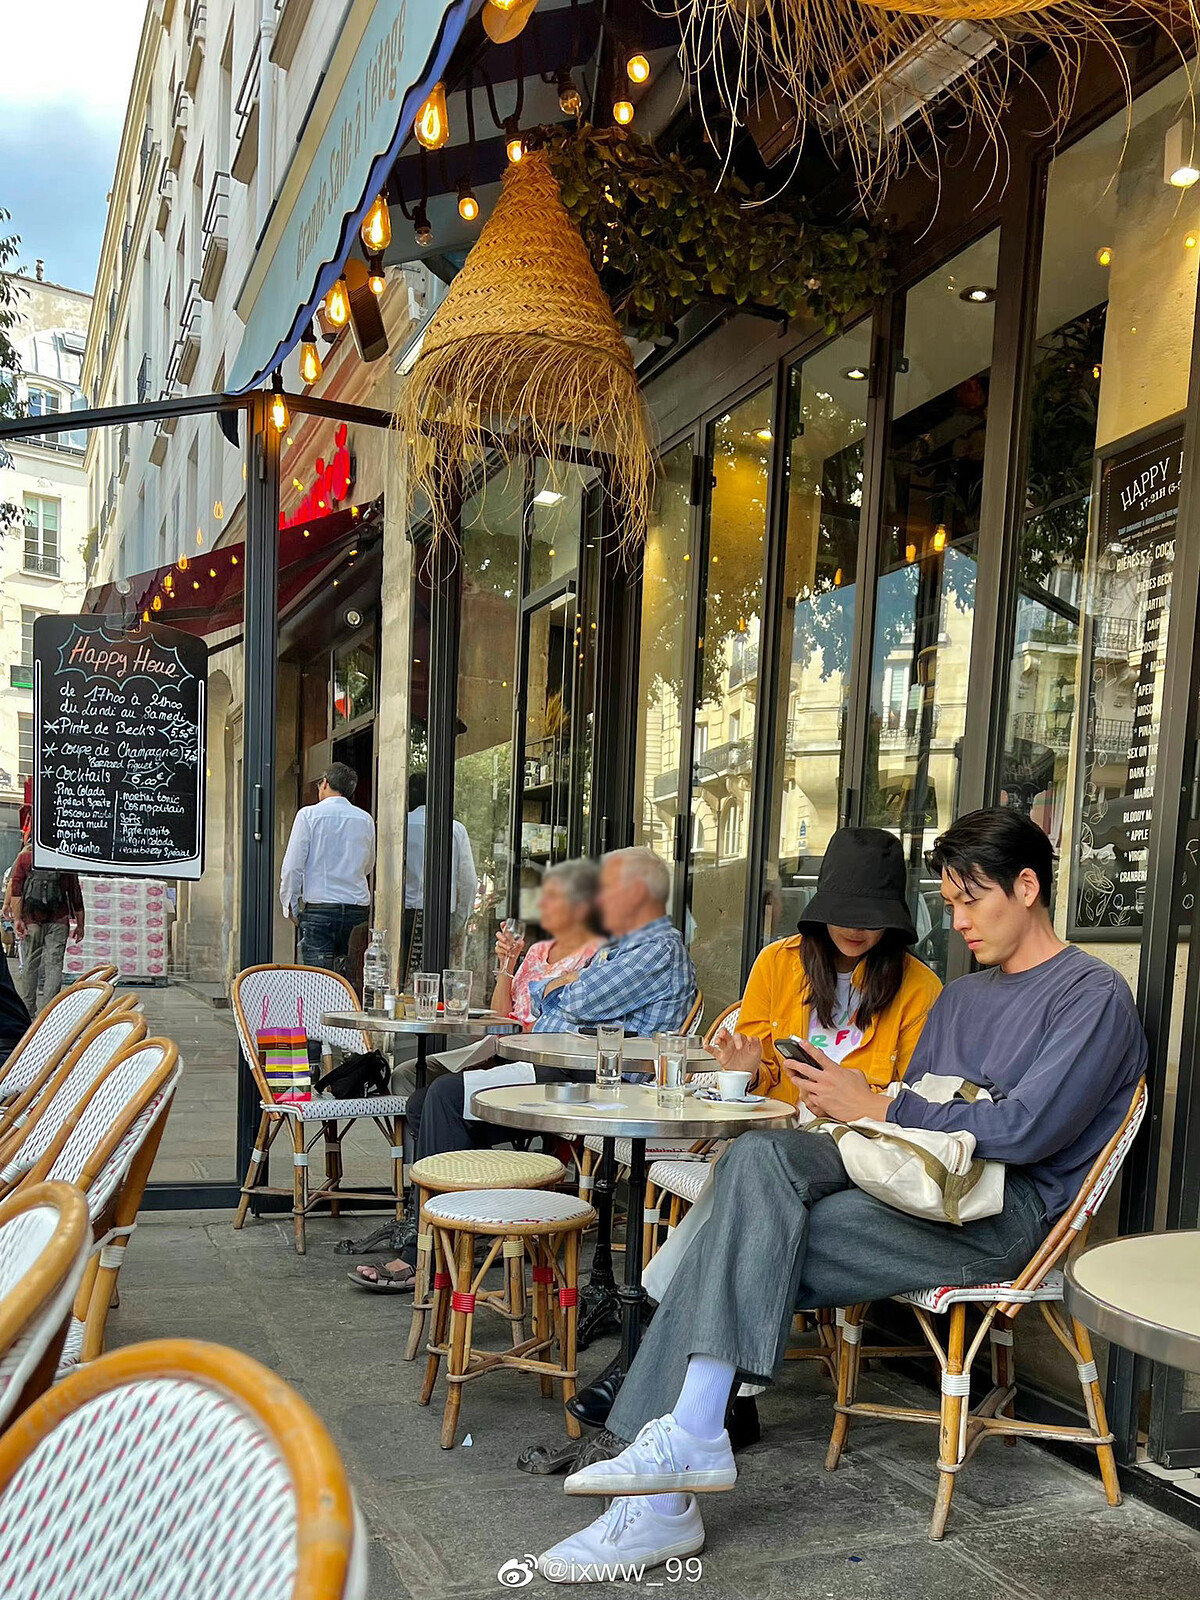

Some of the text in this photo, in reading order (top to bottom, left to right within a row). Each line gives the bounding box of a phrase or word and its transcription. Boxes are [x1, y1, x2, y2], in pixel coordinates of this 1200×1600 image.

[296, 177, 327, 281] Grande
[328, 116, 352, 215] Salle
[354, 87, 361, 159] à
[1120, 456, 1171, 511] HAPPY
[1139, 486, 1166, 511] 17-21H
[1116, 550, 1141, 573] BIÈRES
[68, 636, 128, 678] Happy
[59, 681, 183, 710] de 17h00 à 21h00
[59, 698, 187, 722] du Lundi au Samedi
[59, 716, 92, 735] Pinte
[94, 721, 109, 735] de
[115, 721, 156, 737] Beck's
[94, 743, 110, 757] de
[117, 741, 180, 761] Champagne
[1127, 746, 1139, 760] SEX
[1139, 745, 1148, 758] ON
[55, 764, 111, 783] Cocktails
[1129, 767, 1145, 780] DARK
[1145, 765, 1150, 777] &
[77, 784, 106, 797] Colada
[157, 791, 180, 804] tonic
[56, 806, 91, 819] Moscow
[56, 815, 108, 829] London mule
[1123, 810, 1145, 823] BLOODY
[1130, 829, 1149, 841] APPLE
